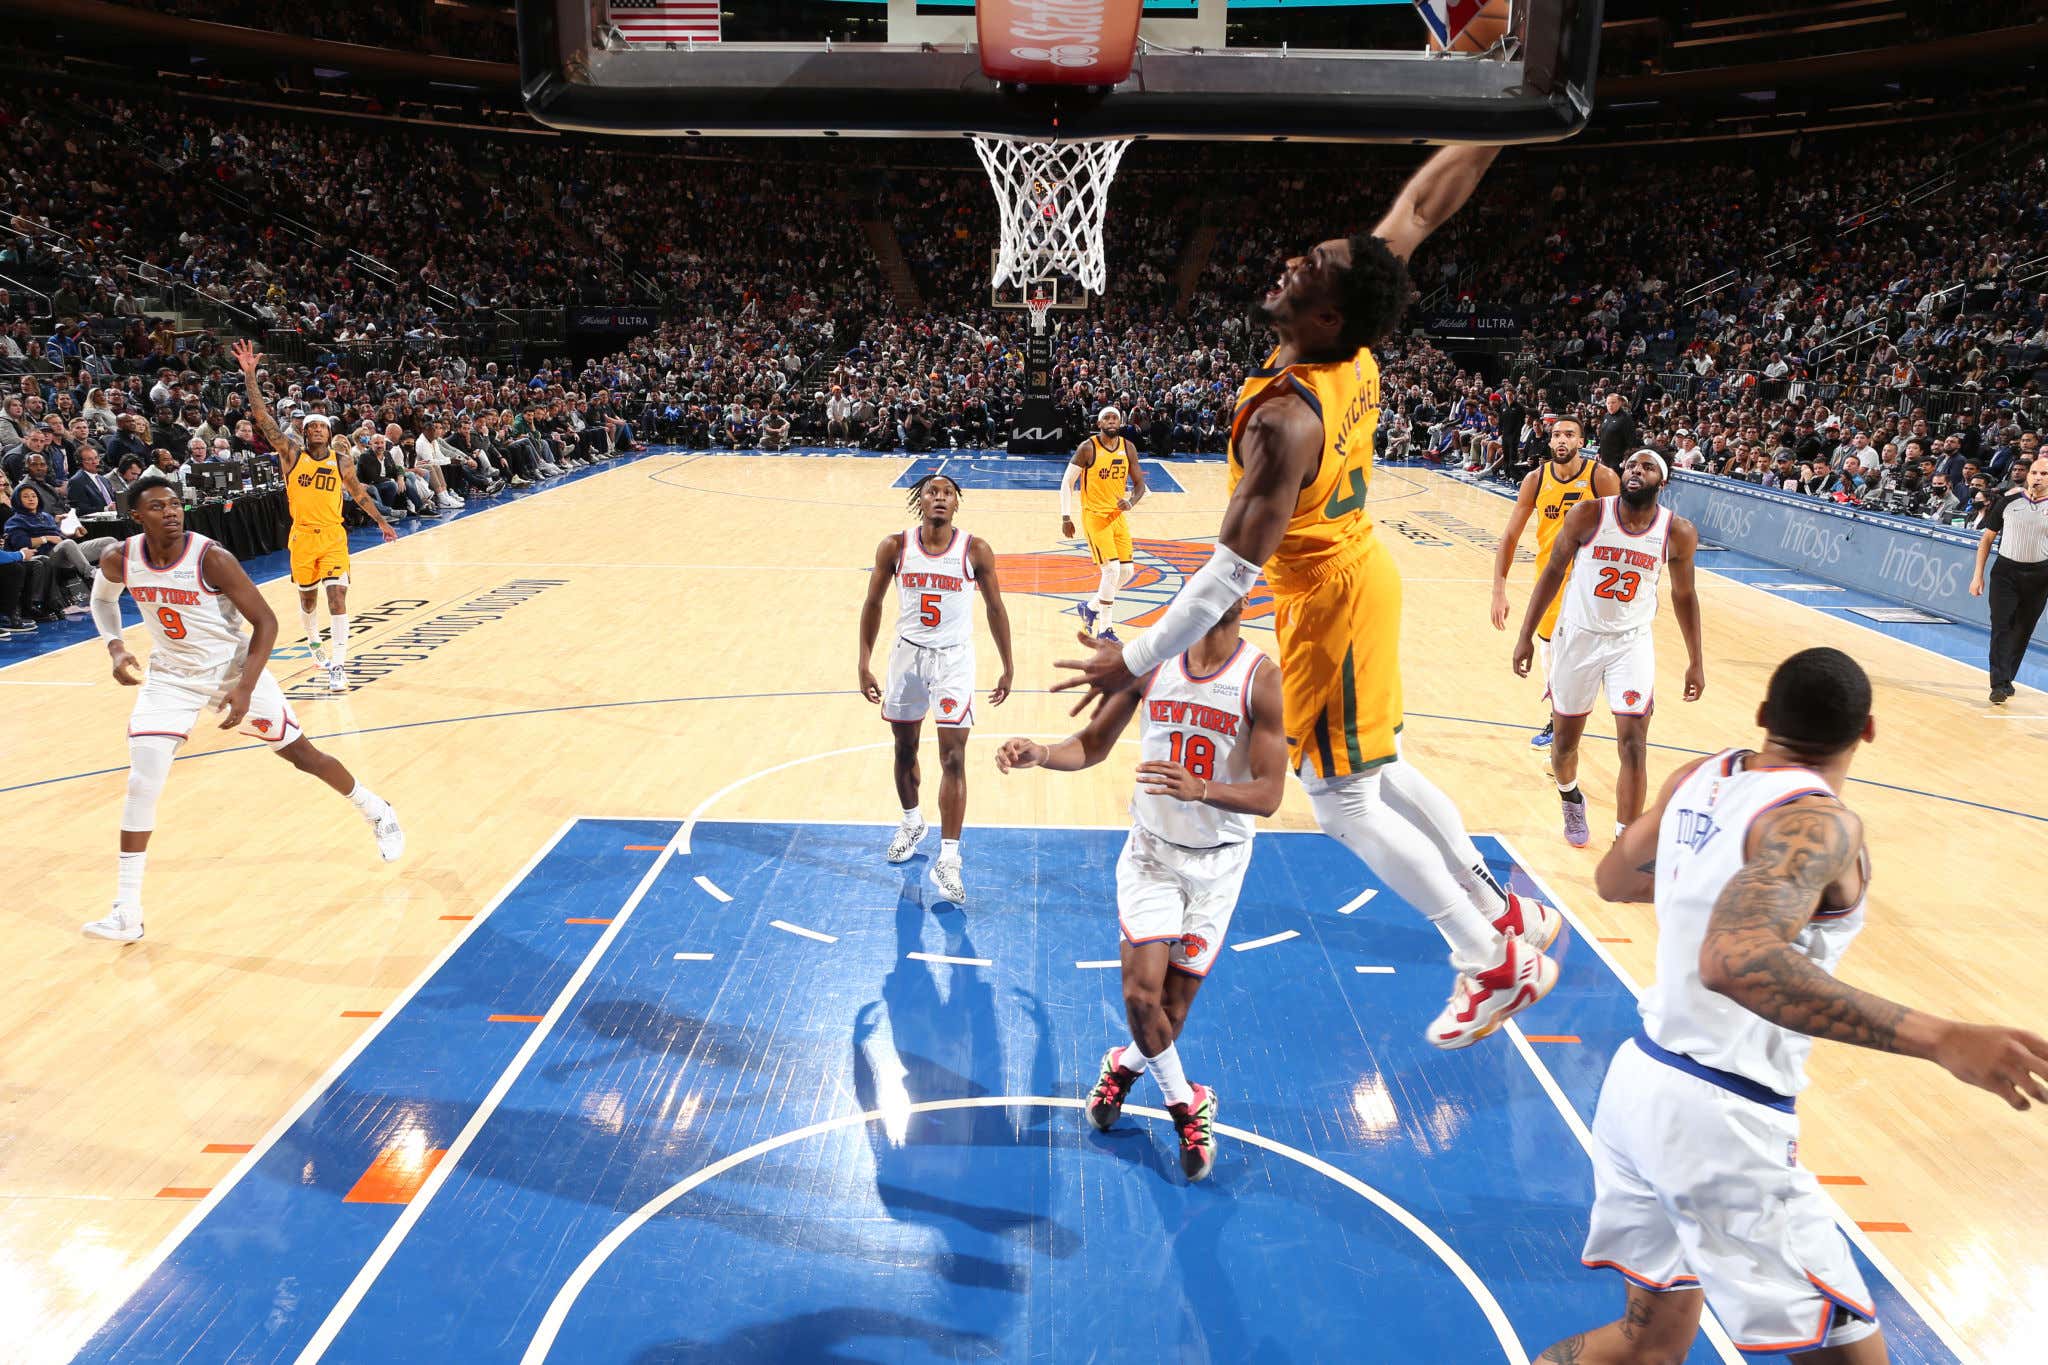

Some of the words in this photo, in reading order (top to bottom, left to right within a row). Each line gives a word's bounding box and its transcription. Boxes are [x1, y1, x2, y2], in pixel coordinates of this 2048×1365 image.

[617, 316, 648, 325] ULTRA
[1477, 318, 1514, 328] ULTRA
[314, 474, 337, 492] 00
[1111, 466, 1126, 479] 23
[1702, 498, 1752, 539] Infosys
[1781, 508, 1842, 568] Infosys
[1592, 546, 1622, 562] NEW
[1624, 548, 1658, 571] YORK
[1878, 536, 1963, 601] Infosys
[131, 587, 157, 603] NEW
[162, 587, 201, 605] YORK
[901, 572, 929, 588] NEW
[931, 573, 963, 592] YORK
[1594, 566, 1641, 602] 23
[156, 606, 187, 639] 9
[920, 593, 941, 627] 5
[1149, 700, 1188, 723] NEW
[1189, 703, 1240, 737] YORK
[1169, 731, 1216, 780] 18
